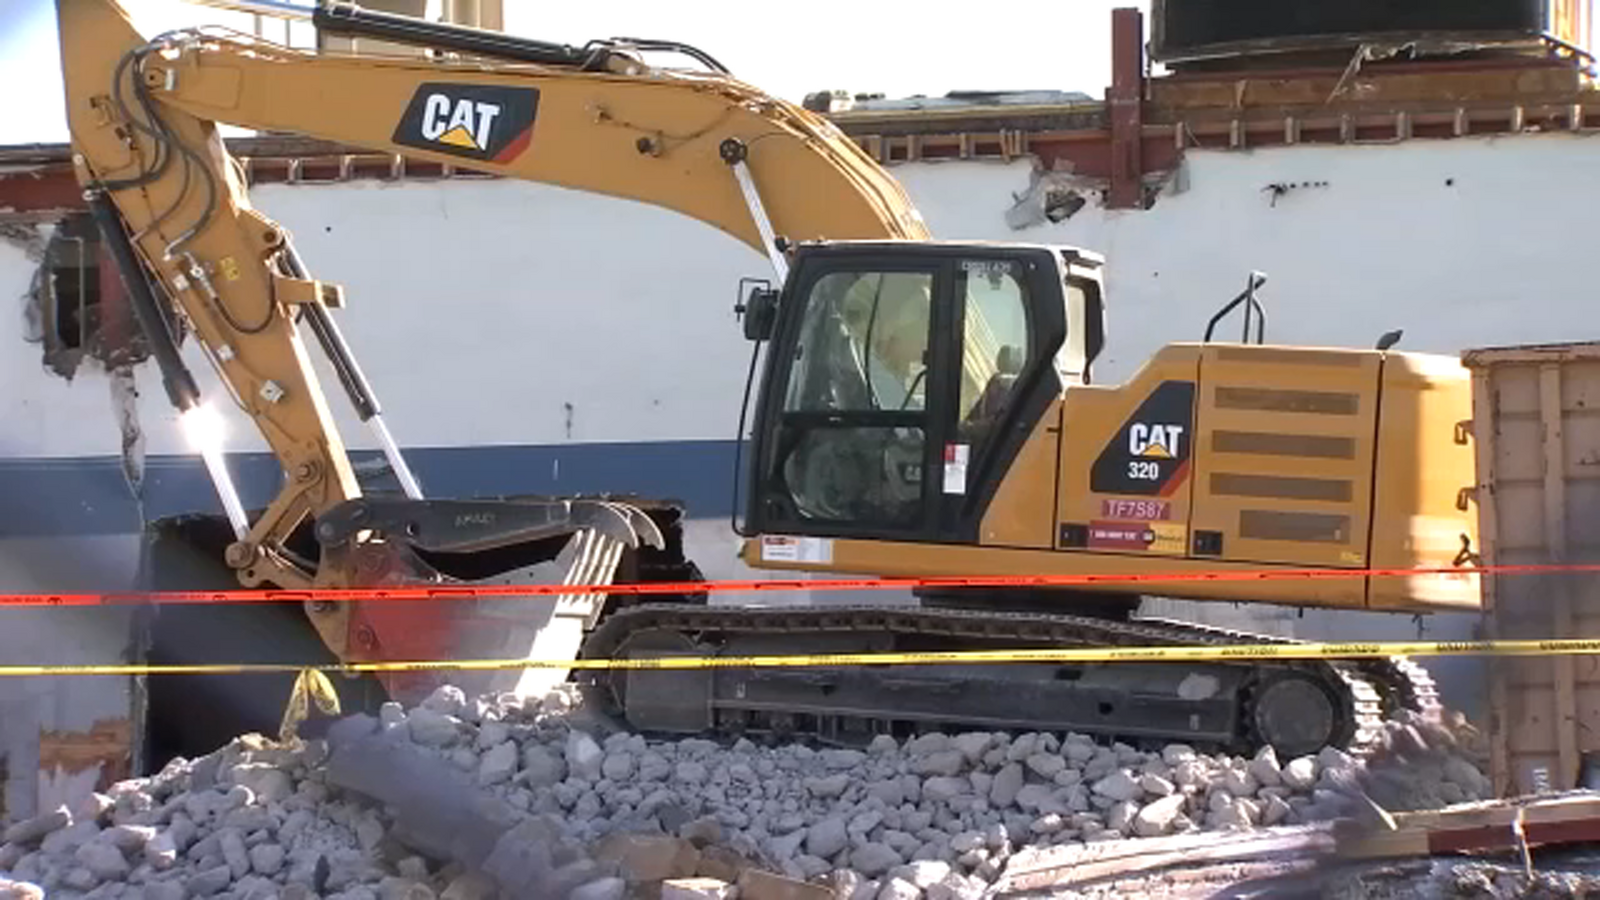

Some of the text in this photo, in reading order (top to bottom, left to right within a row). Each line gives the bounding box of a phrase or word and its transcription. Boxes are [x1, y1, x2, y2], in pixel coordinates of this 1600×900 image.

[421, 93, 500, 150] CAT
[1129, 423, 1183, 458] CAT
[1128, 462, 1159, 480] 320
